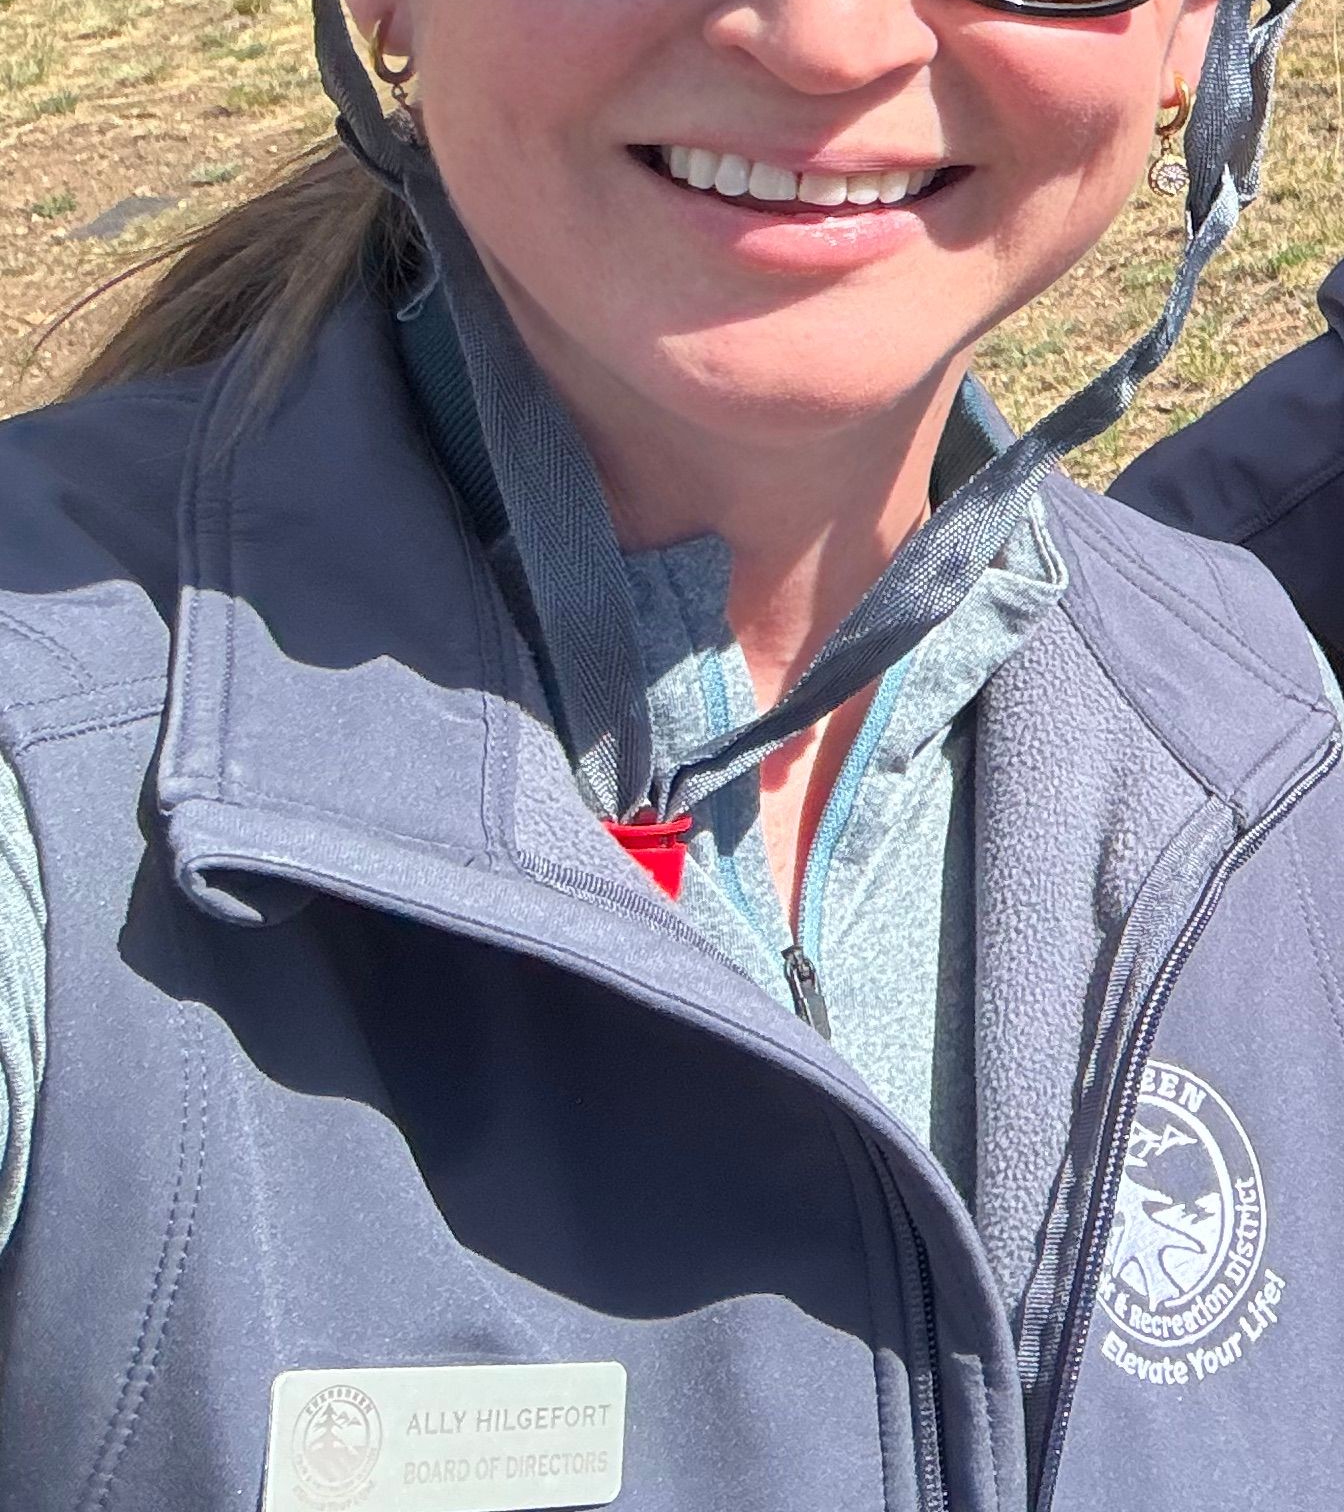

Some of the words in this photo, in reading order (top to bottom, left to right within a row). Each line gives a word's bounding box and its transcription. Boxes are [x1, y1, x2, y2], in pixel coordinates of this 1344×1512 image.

[1129, 1281, 1234, 1338] Recreation
[1224, 1175, 1256, 1285] District
[1100, 1329, 1190, 1385] Elevate
[1187, 1332, 1243, 1381] Your
[1238, 1267, 1287, 1343] Life!
[405, 1409, 467, 1436] ALLY
[476, 1403, 612, 1433] HILGEFORT
[403, 1458, 471, 1485] BOARD
[475, 1456, 501, 1481] OF
[505, 1450, 609, 1480] DIRECTORS
